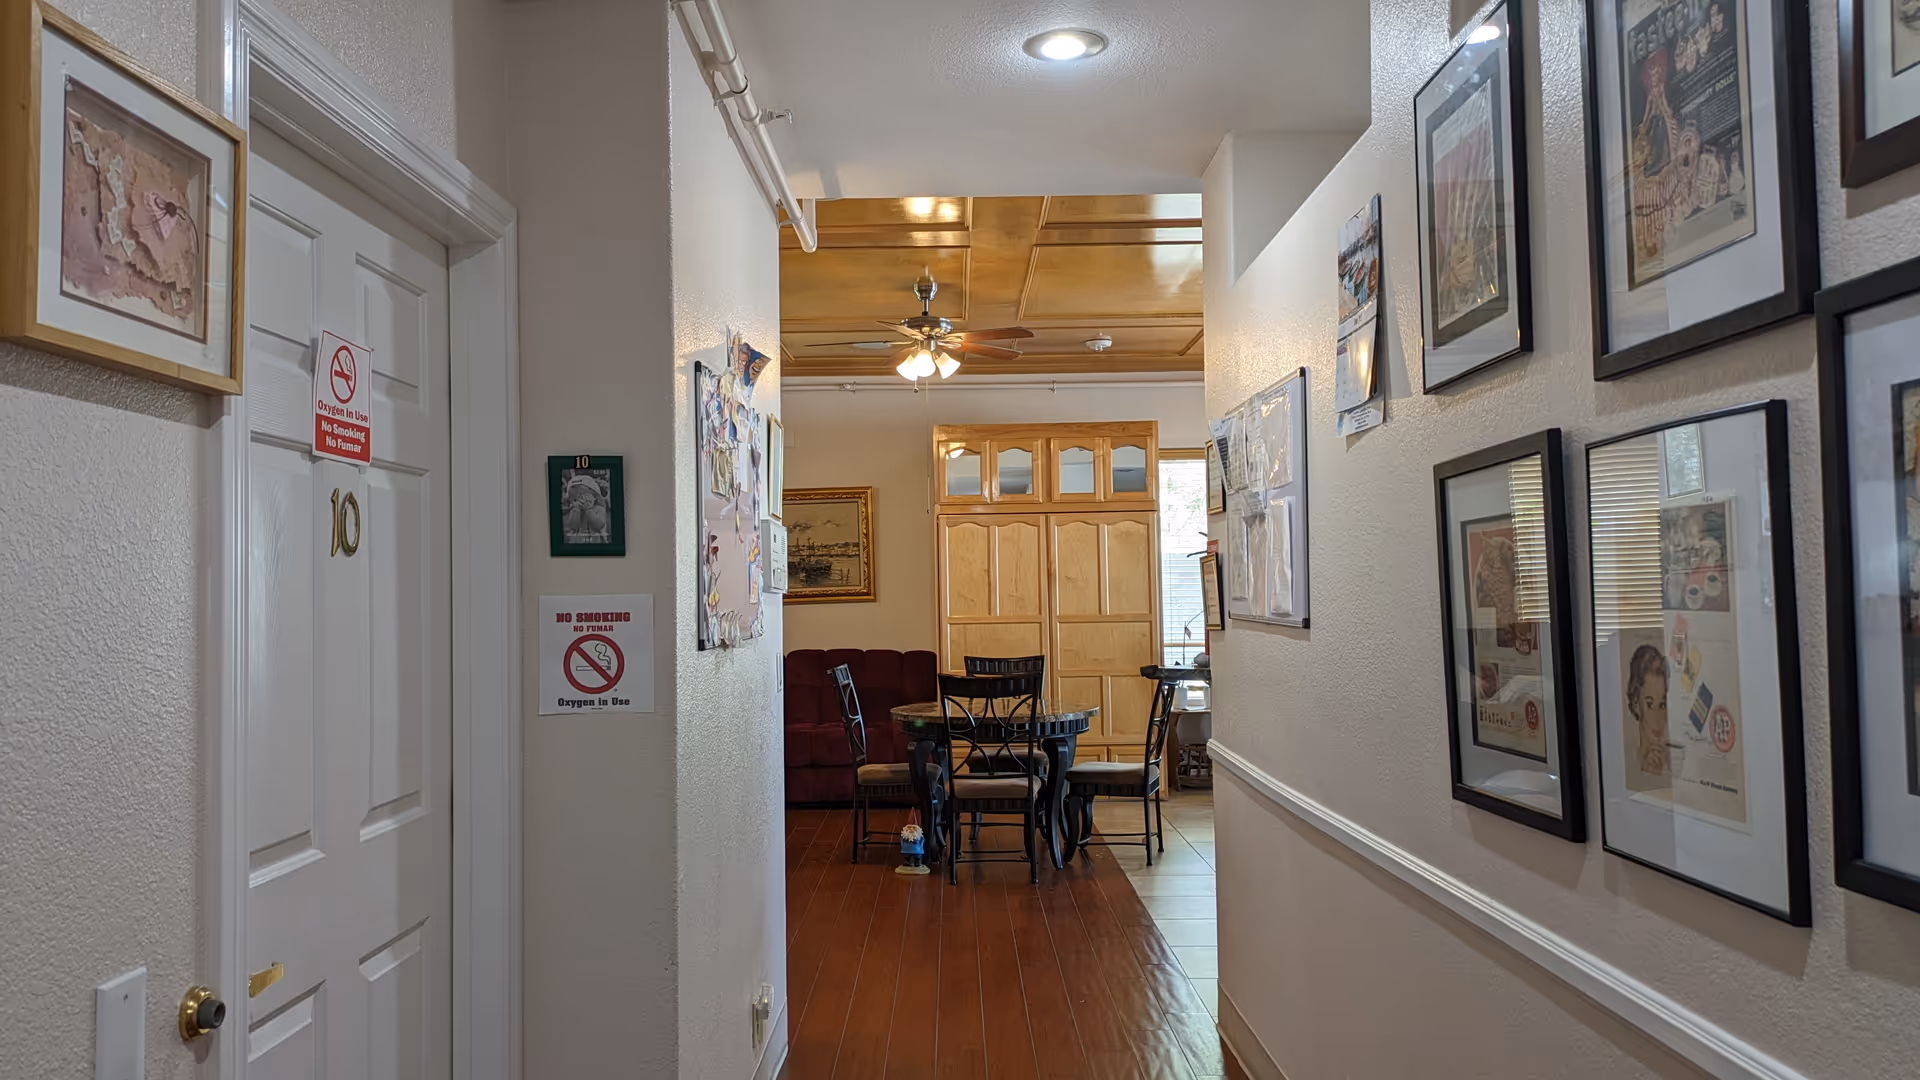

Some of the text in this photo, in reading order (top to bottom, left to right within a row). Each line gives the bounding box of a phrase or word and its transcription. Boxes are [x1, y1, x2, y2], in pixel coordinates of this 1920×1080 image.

[317, 399, 369, 423] Oxygen In Use
[321, 420, 366, 443] No Smoking
[326, 435, 362, 453] No Fumar
[575, 455, 589, 469] 10
[331, 487, 361, 557] 10
[556, 611, 631, 623] NO SMOKING
[573, 624, 614, 632] NO FUMAR
[558, 697, 630, 708] Oxygen in Use
